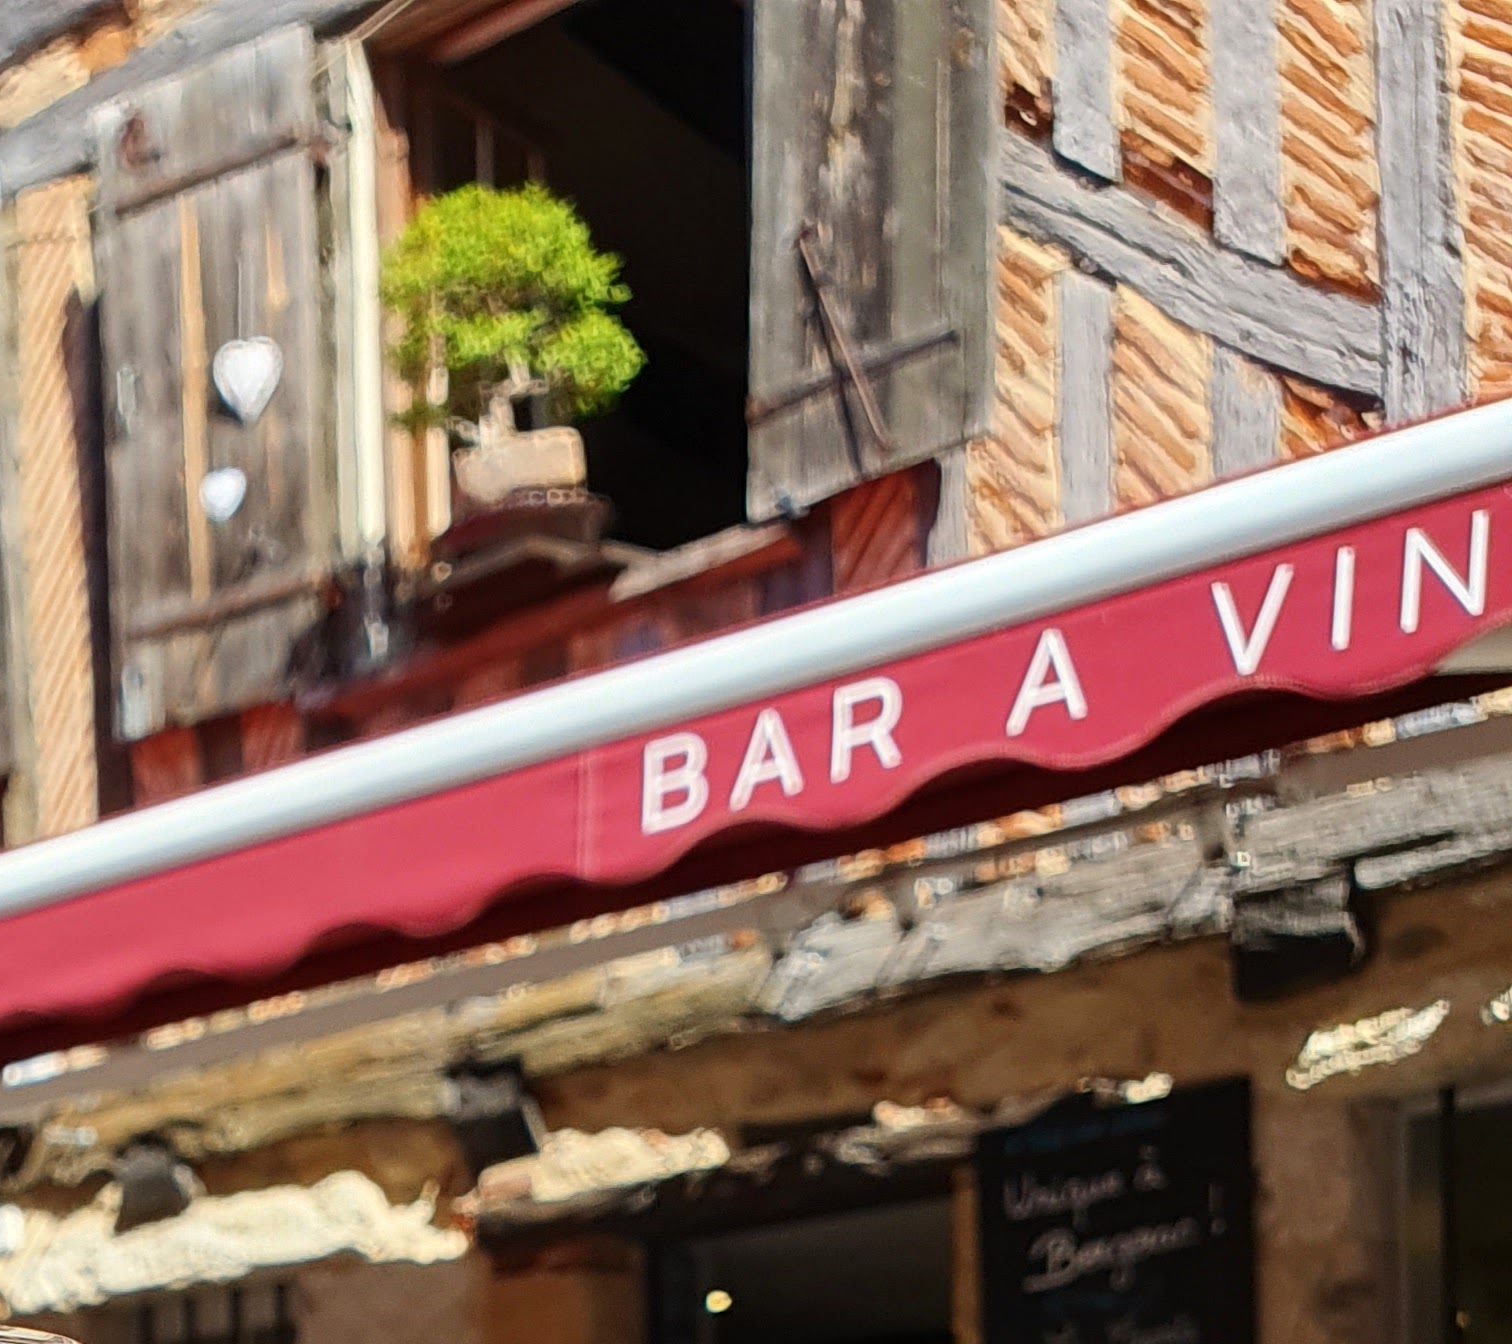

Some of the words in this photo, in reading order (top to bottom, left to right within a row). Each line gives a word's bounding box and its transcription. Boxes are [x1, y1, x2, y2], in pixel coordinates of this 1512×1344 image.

[640, 675, 904, 837] BAR
[1006, 628, 1089, 736] A
[1211, 509, 1490, 677] VIN
